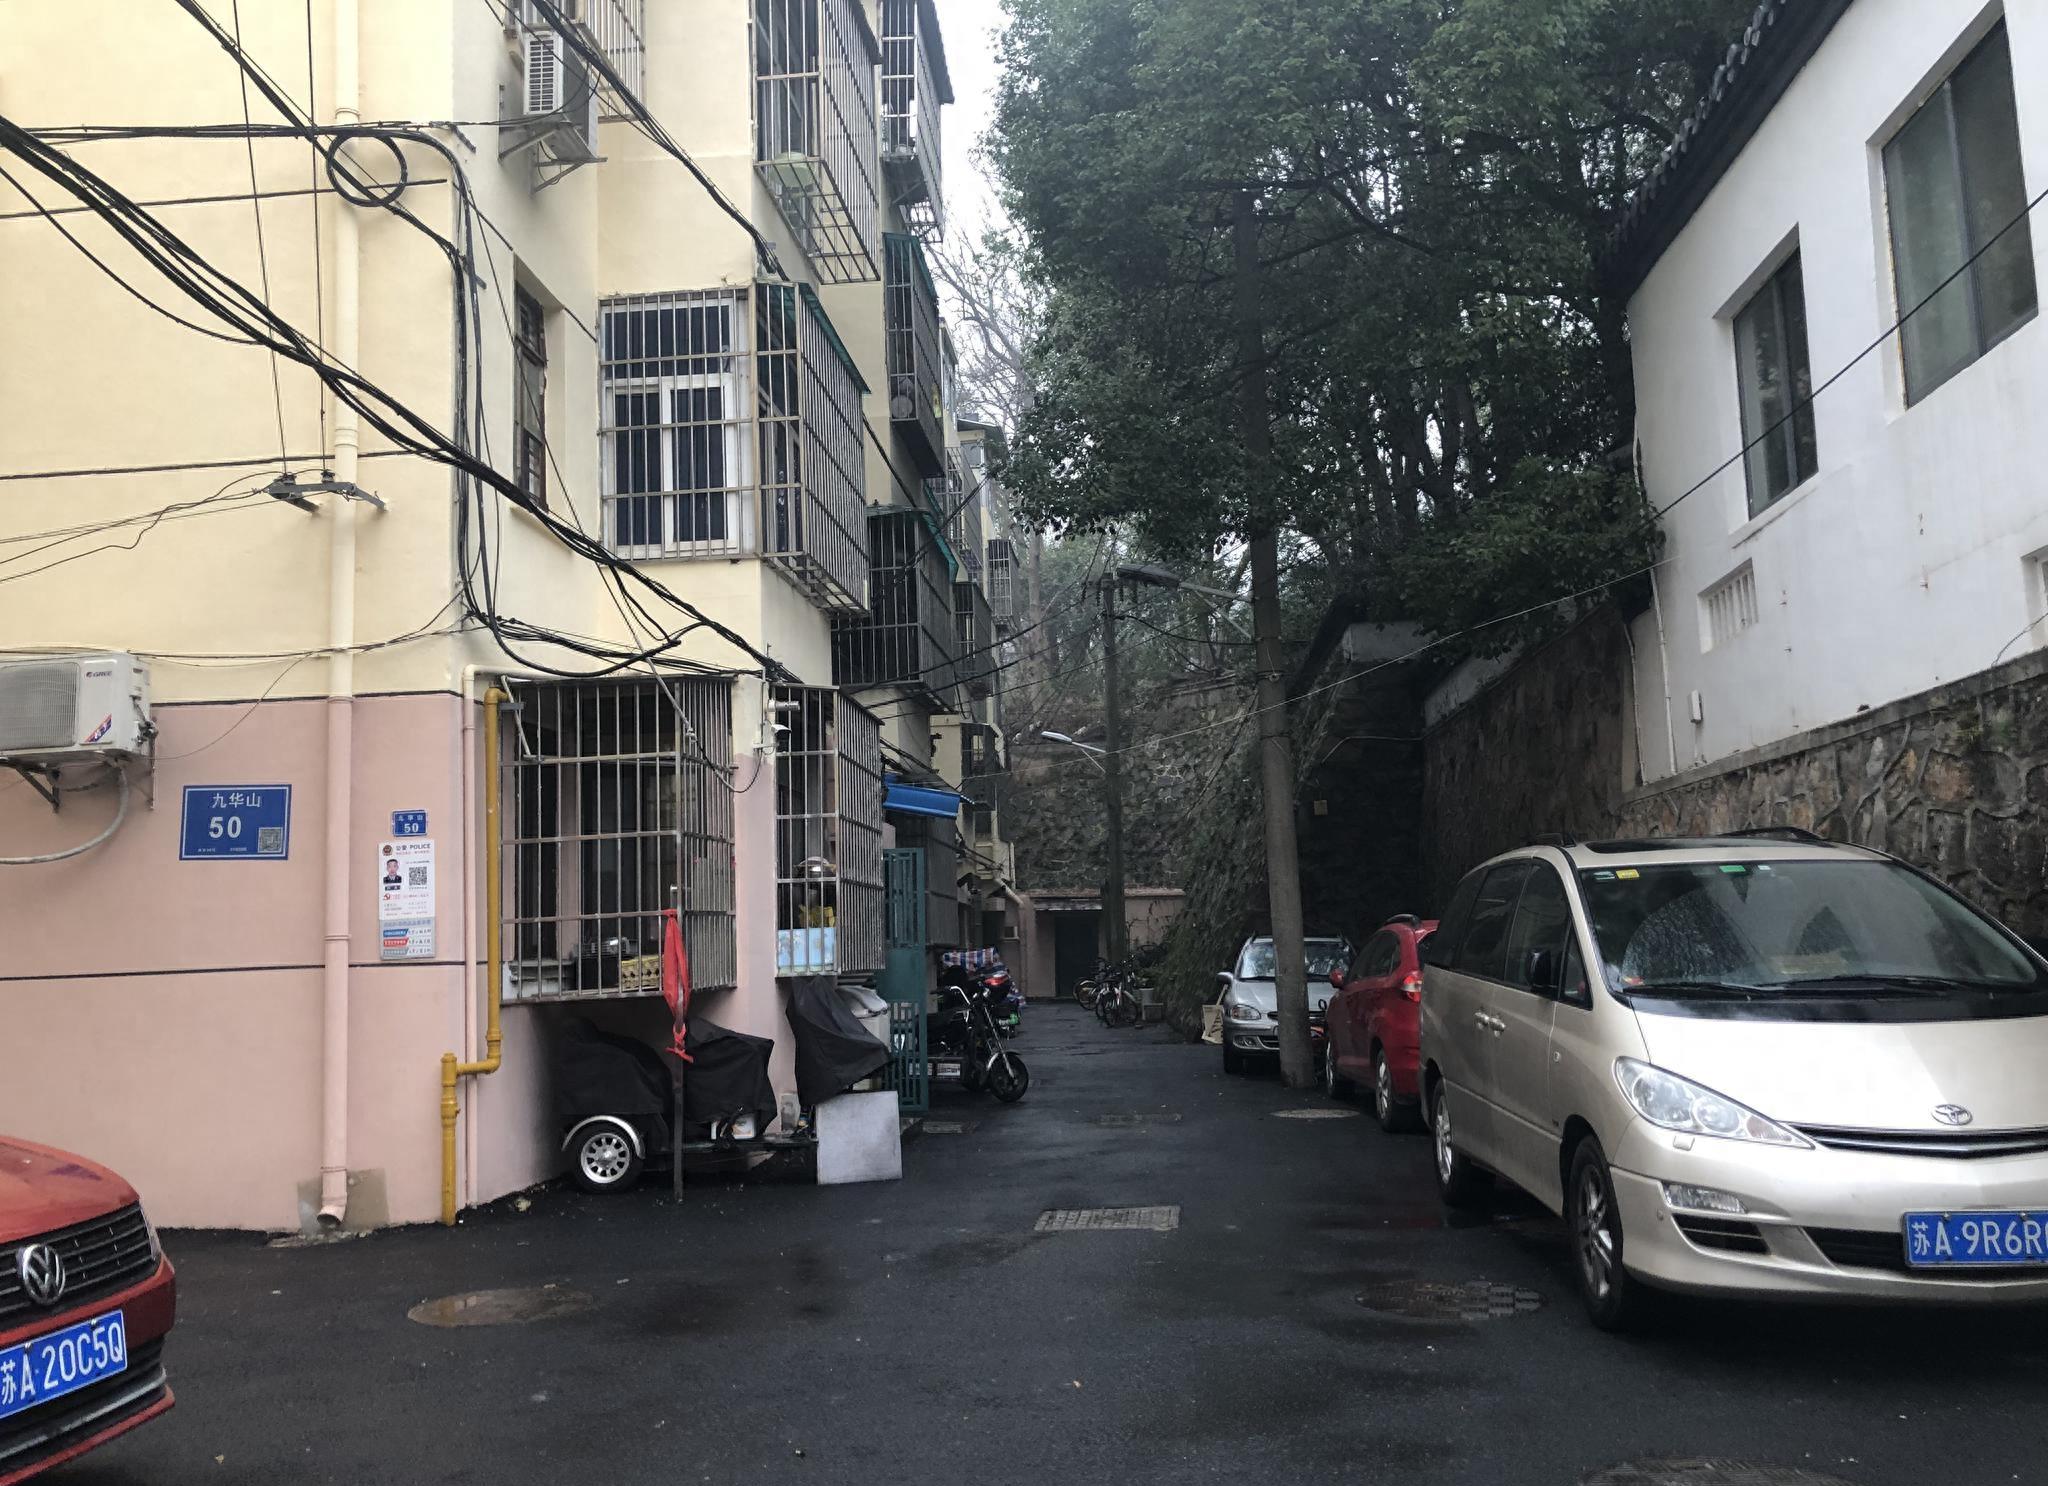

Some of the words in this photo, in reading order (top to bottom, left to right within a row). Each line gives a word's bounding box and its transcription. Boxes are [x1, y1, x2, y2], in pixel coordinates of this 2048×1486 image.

[212, 793, 261, 808] 九华山
[209, 816, 241, 838] 50
[404, 823, 419, 833] 50
[1912, 1220, 2048, 1256] 苏A·9R6R
